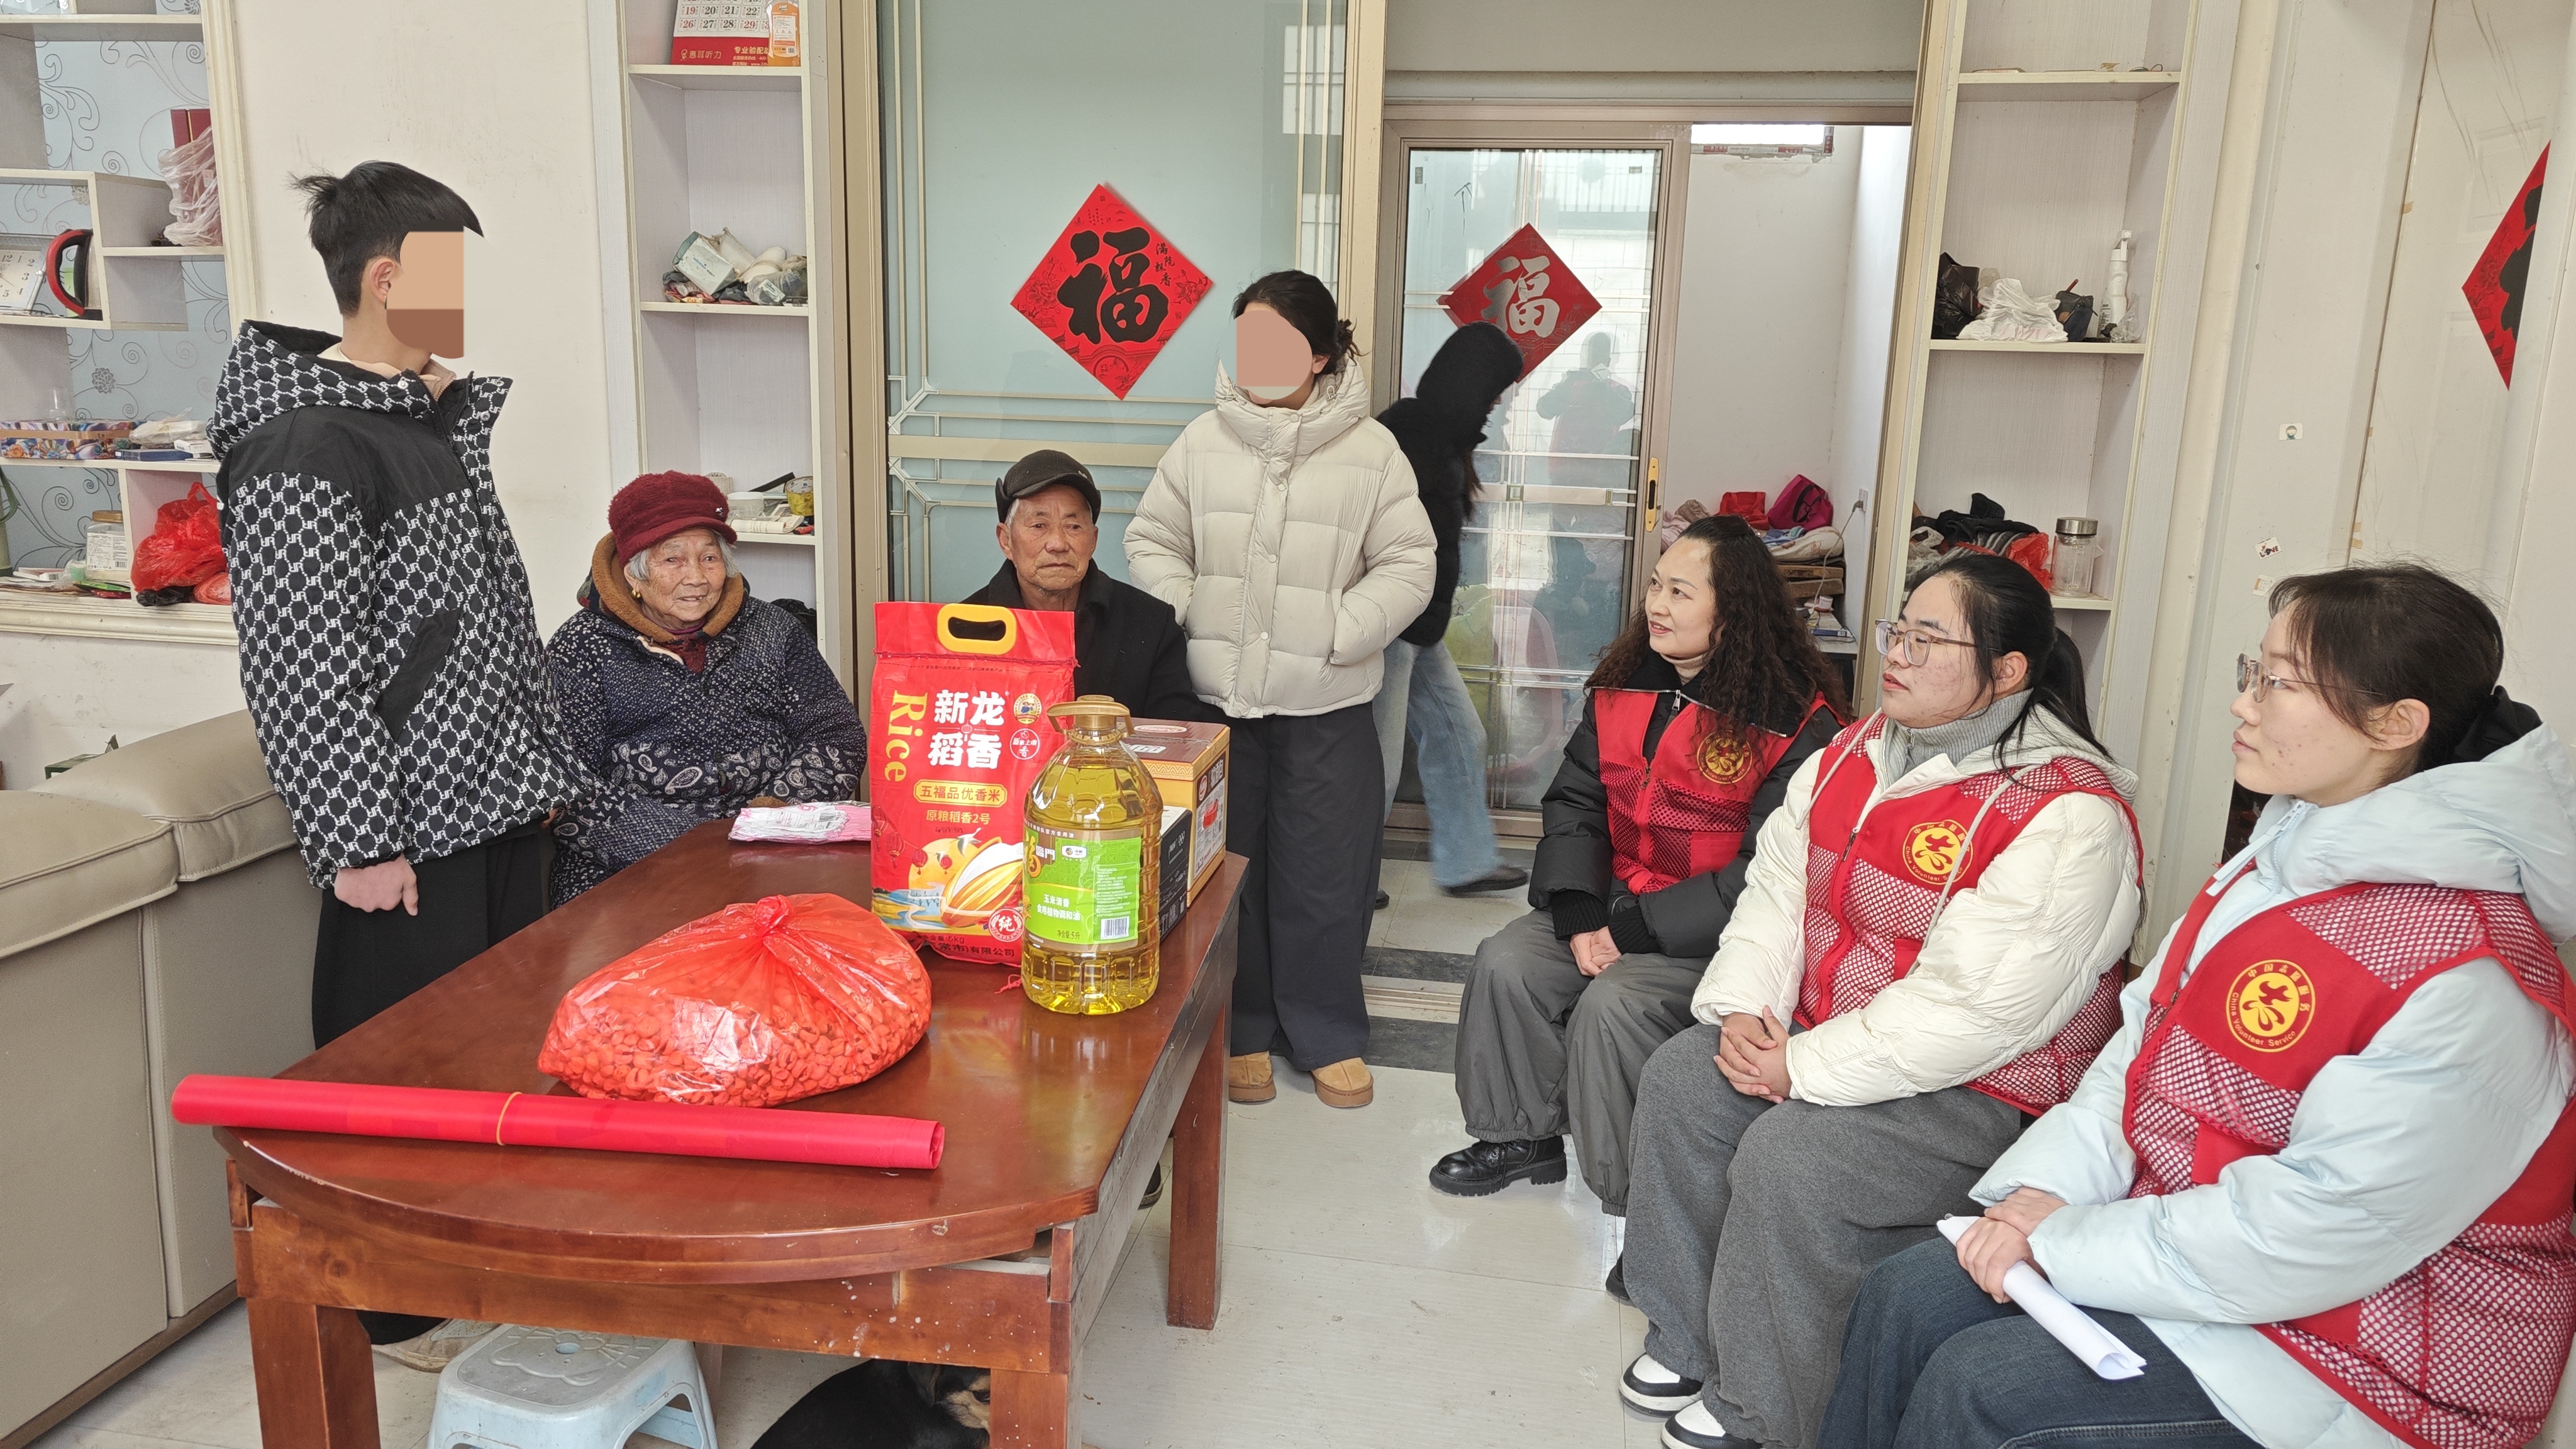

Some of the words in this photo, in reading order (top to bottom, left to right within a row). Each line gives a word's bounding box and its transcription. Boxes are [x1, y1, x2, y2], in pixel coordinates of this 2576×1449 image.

[685, 6, 696, 15] 19
[704, 6, 716, 14] 20
[724, 6, 735, 14] 21
[746, 7, 757, 16] 22
[683, 20, 694, 28] 26
[703, 20, 714, 28] 27
[723, 19, 734, 28] 28
[744, 20, 755, 29] 29
[689, 50, 722, 59] 惠耳听力
[26, 258, 35, 267] 2
[21, 272, 30, 280] 3
[3, 289, 10, 297] 5
[1057, 226, 1169, 345] 福
[1480, 255, 1560, 338] 福
[934, 689, 1006, 726] 新龙
[884, 690, 928, 782] Rice
[928, 731, 1002, 769] 稻香
[920, 785, 1001, 802] 五福品优香米
[926, 809, 991, 825] 原粮稻香2号
[1912, 864, 1940, 881] Volunteer
[1043, 894, 1070, 908] 玉米清香
[1036, 904, 1081, 921] 食用植物调和油
[998, 914, 1015, 932] 纯
[2248, 963, 2311, 1011] 中国志愿服务
[2231, 992, 2240, 1016] China
[2233, 1018, 2264, 1045] Volunteer
[2268, 1031, 2296, 1046] Service
